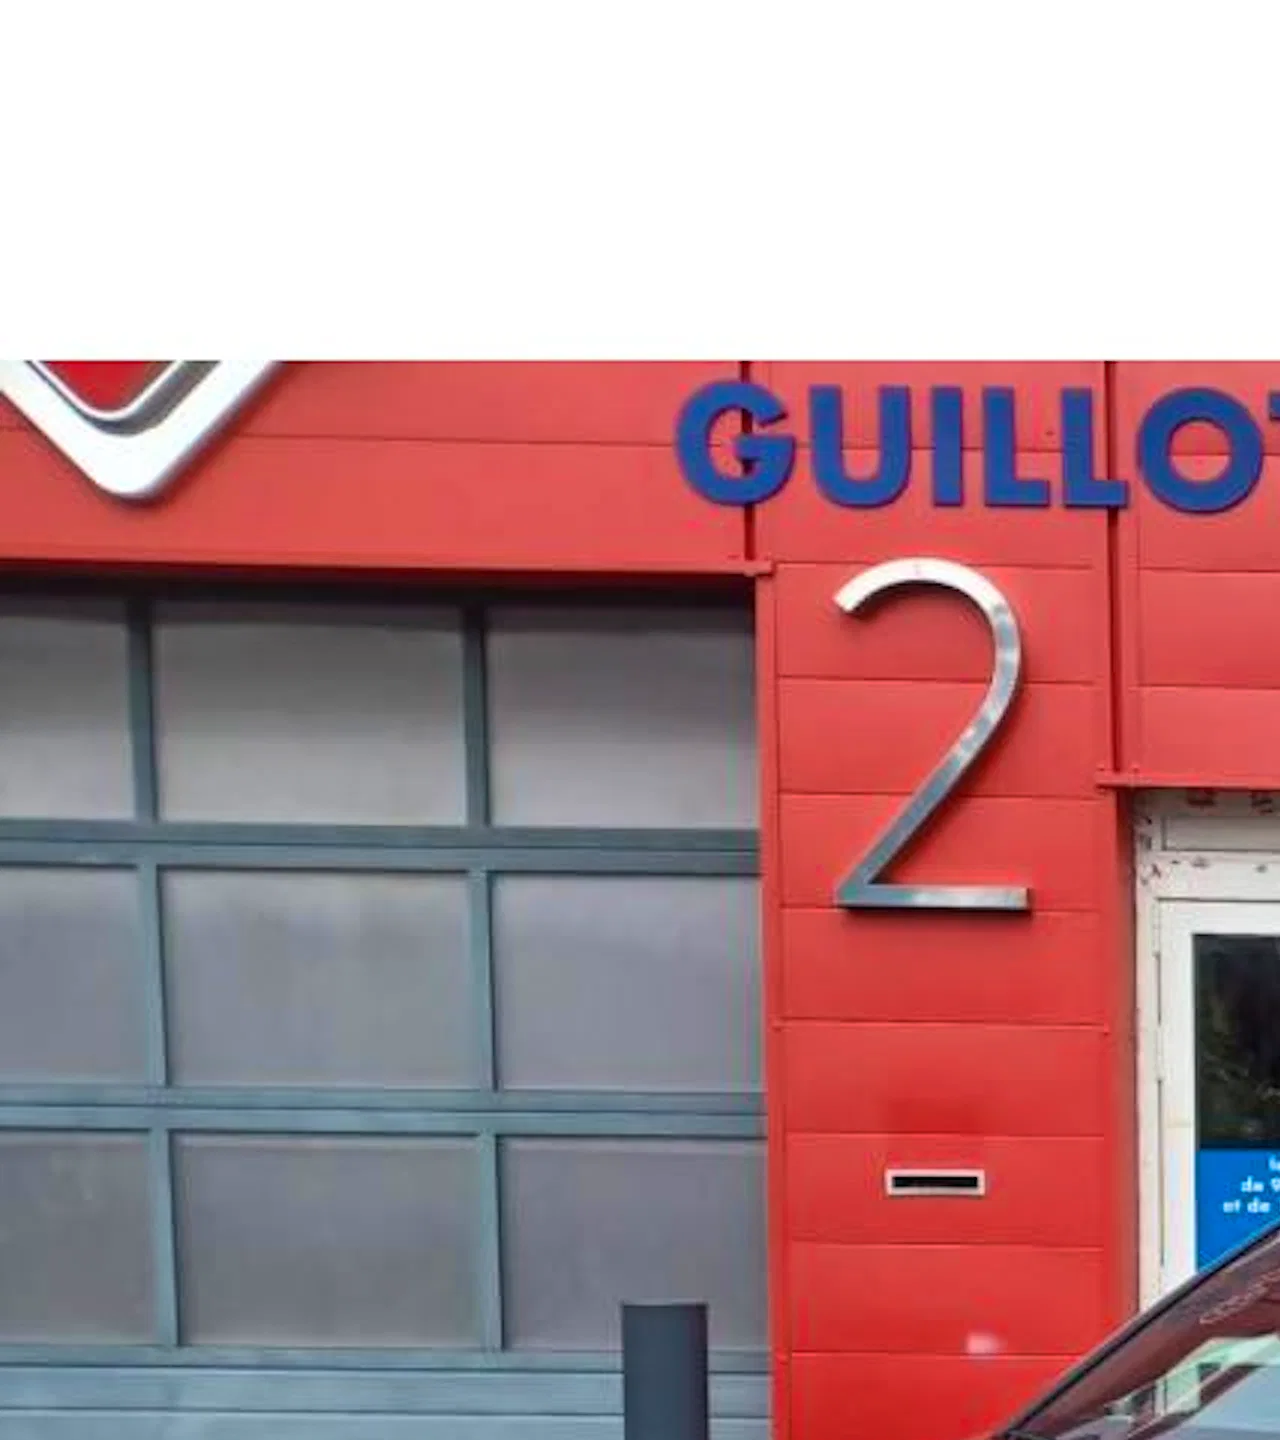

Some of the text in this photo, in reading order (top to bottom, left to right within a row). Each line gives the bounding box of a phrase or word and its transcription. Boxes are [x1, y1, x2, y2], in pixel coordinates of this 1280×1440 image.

[833, 556, 1031, 911] 2
[1240, 1176, 1265, 1193] de
[1222, 1198, 1241, 1214] et
[1246, 1197, 1271, 1214] de
